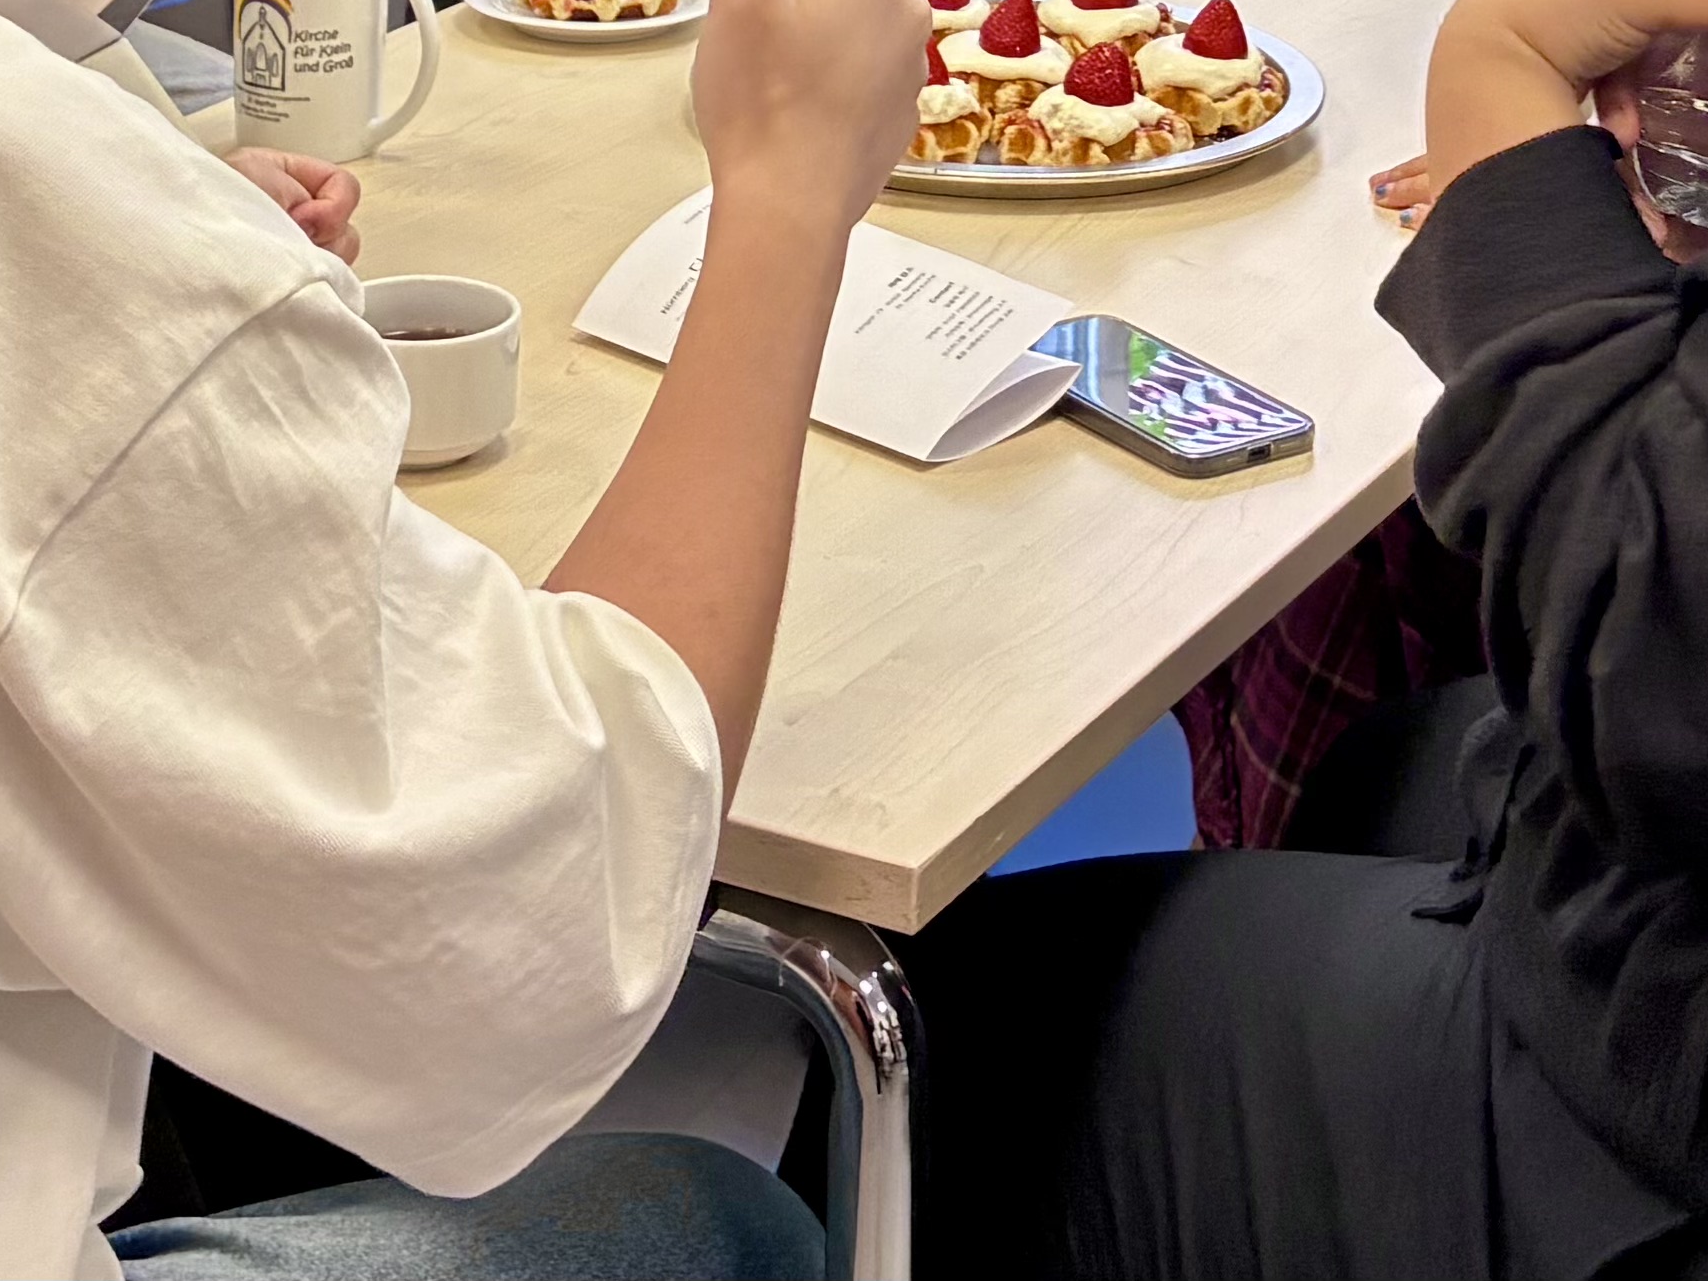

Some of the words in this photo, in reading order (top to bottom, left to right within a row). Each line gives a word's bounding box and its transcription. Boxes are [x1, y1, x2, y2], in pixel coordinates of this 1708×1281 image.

[294, 29, 338, 43] Kirche
[294, 46, 315, 59] für
[319, 43, 351, 58] Klein
[294, 61, 320, 73] und
[323, 56, 354, 73] Groß
